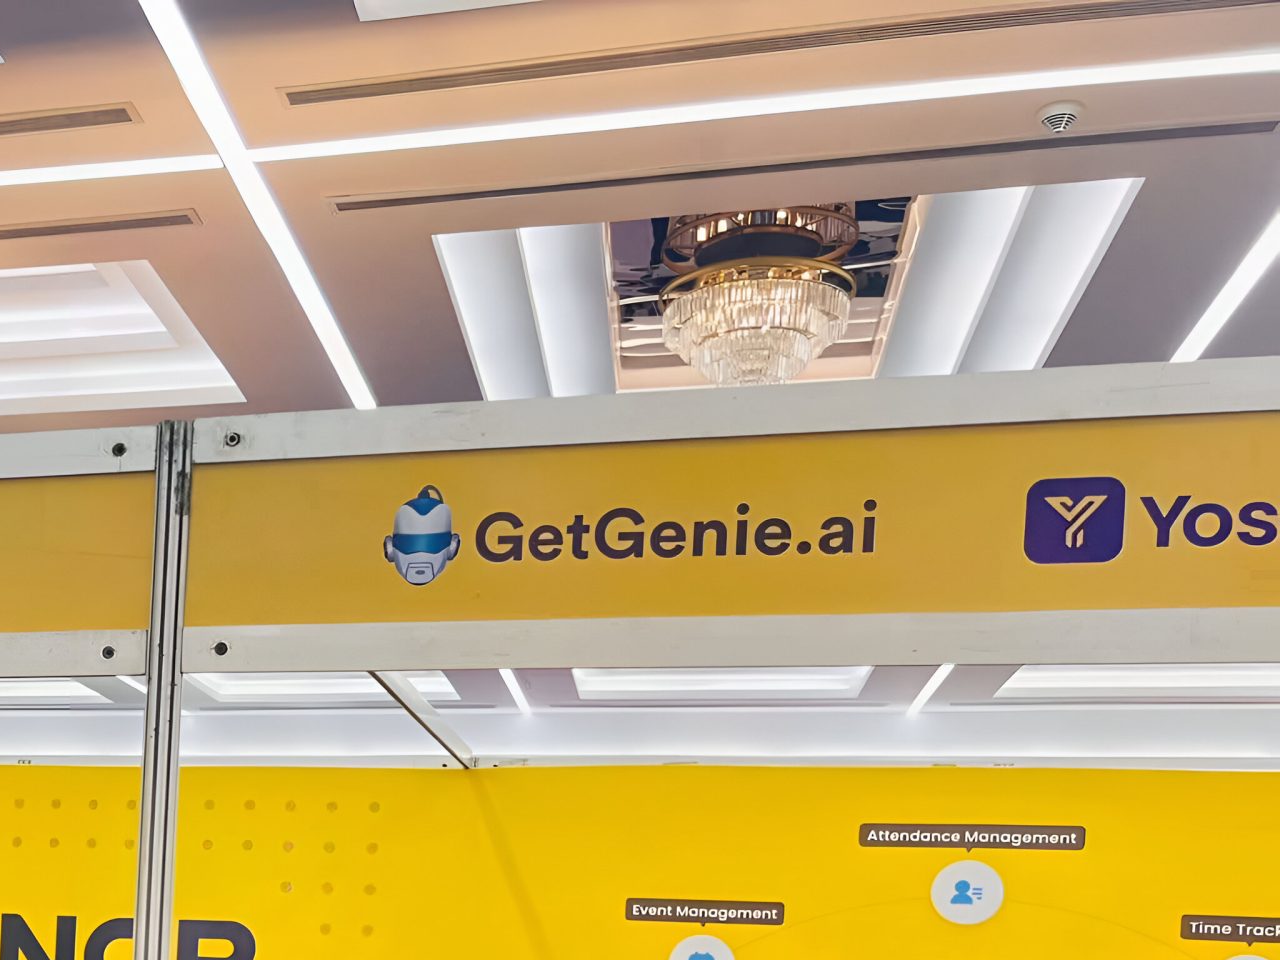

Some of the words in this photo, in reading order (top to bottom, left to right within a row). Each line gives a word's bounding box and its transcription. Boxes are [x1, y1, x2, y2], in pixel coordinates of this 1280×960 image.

[1139, 494, 1279, 548] Yos
[475, 499, 877, 563] GetGenie.ai
[867, 829, 960, 843] Attendance
[964, 831, 1077, 847] Management
[632, 904, 672, 916] Event
[676, 906, 778, 922] Management
[1189, 921, 1232, 934] Time
